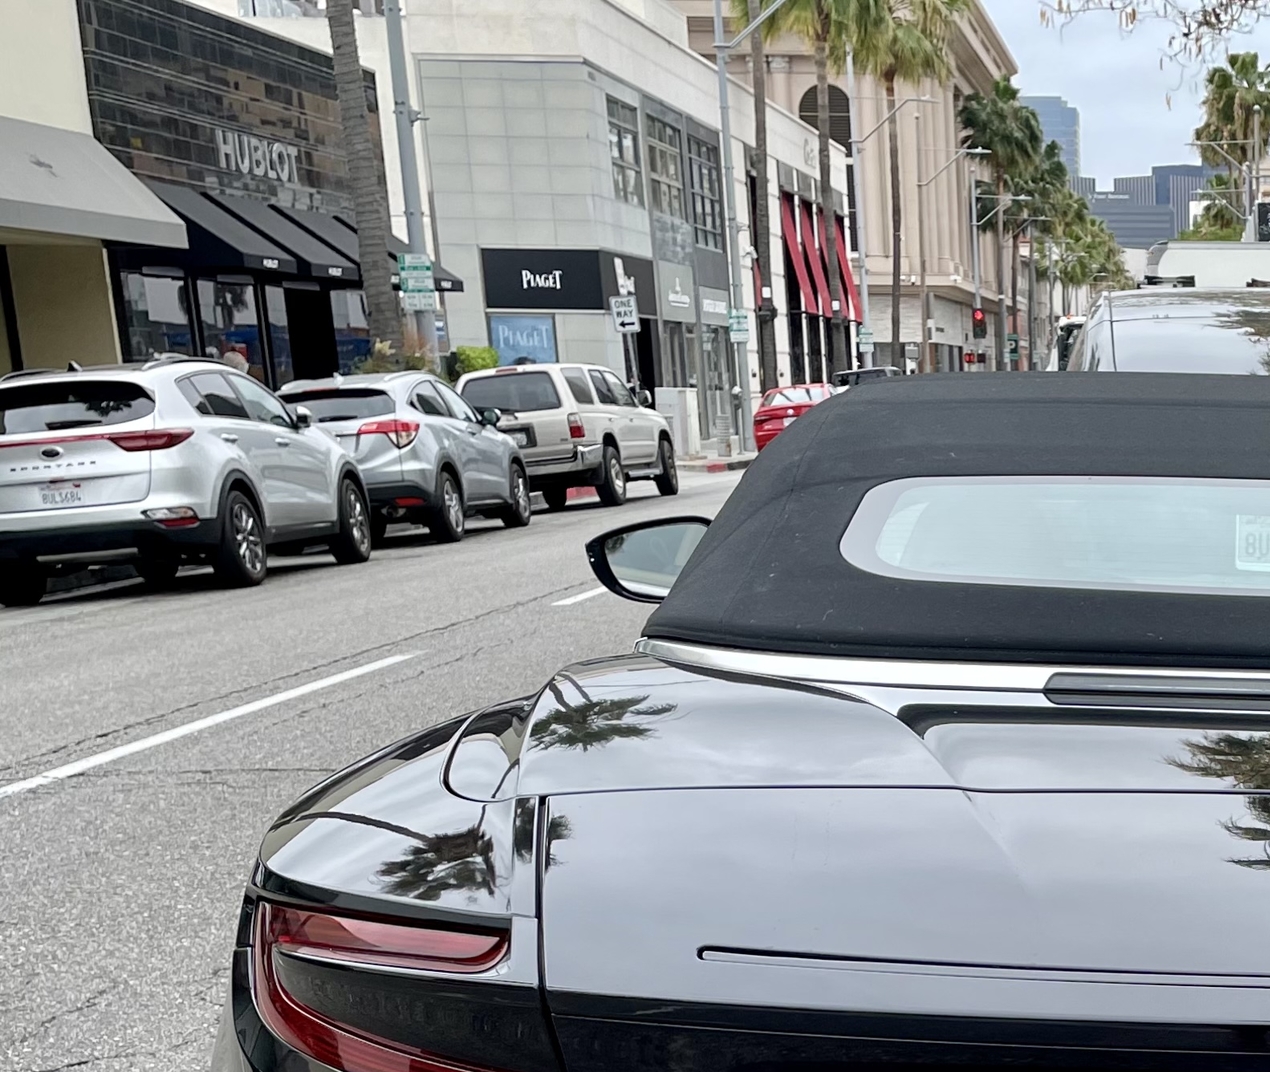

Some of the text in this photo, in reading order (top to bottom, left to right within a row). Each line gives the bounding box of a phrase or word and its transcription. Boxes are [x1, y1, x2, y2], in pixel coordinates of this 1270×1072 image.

[215, 129, 298, 183] HUBLOT
[522, 270, 562, 289] PIAGET
[614, 299, 632, 308] ONE
[616, 310, 633, 318] WAY
[499, 324, 549, 348] PIAGET
